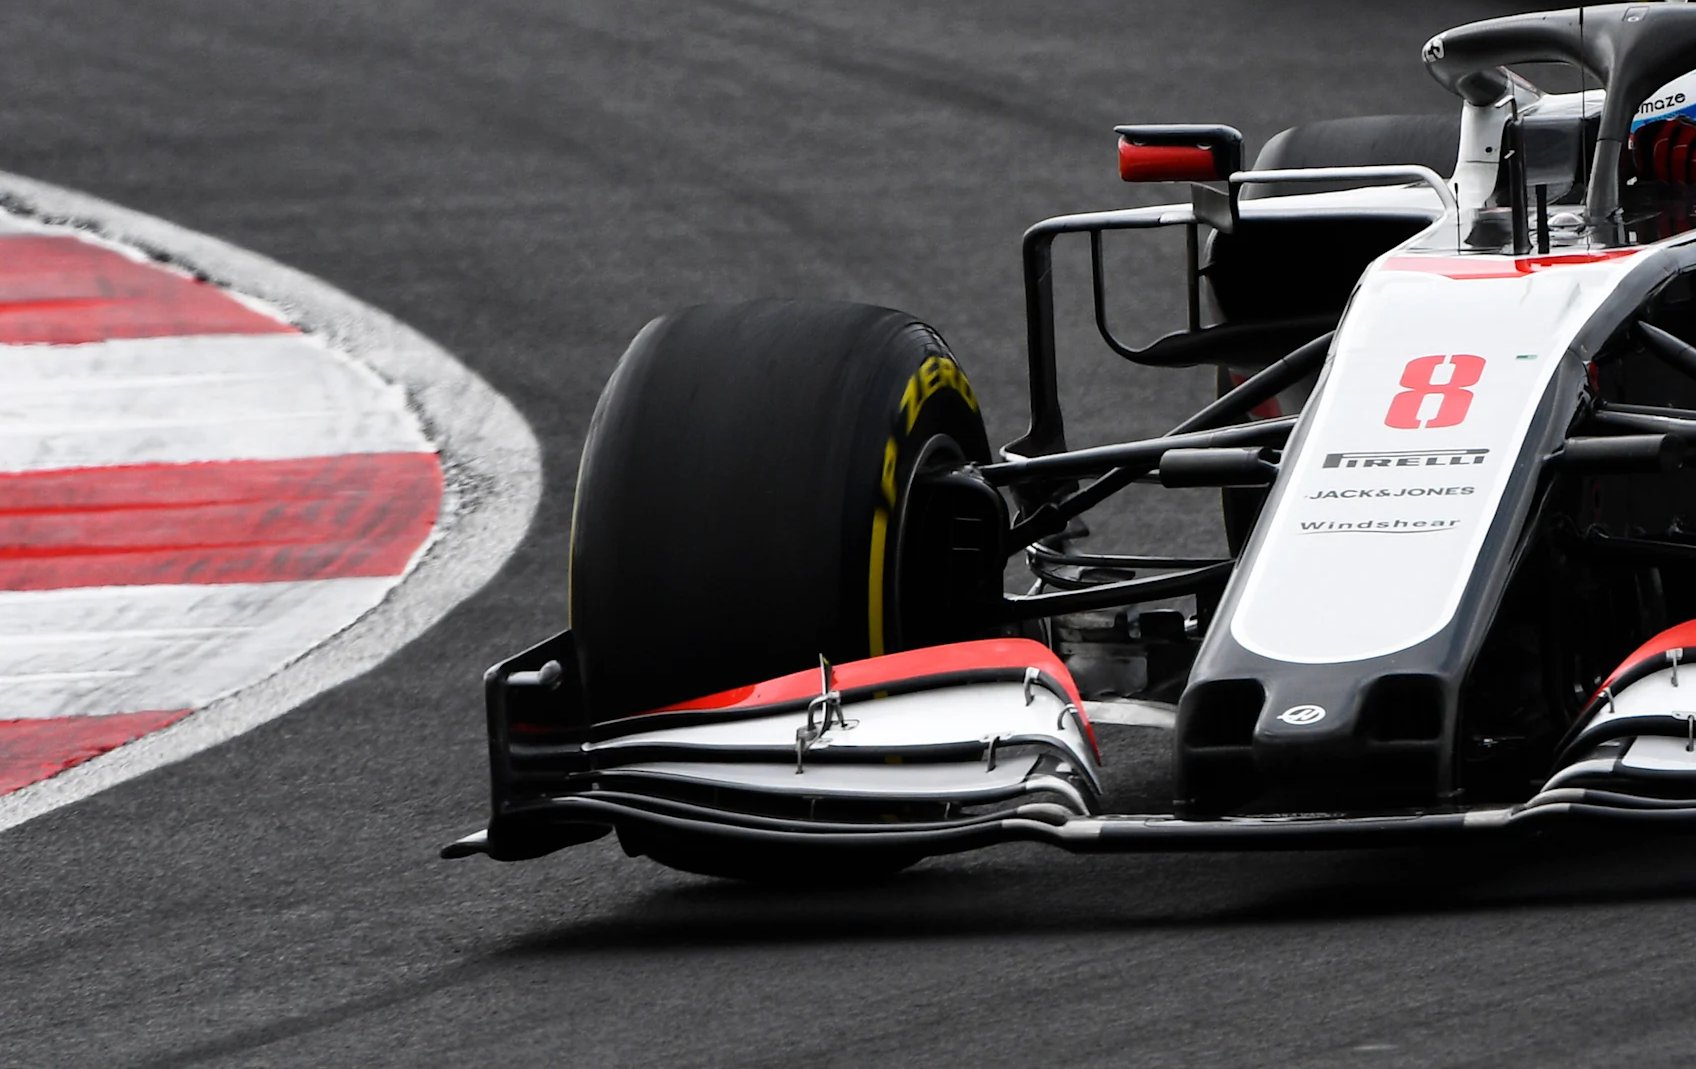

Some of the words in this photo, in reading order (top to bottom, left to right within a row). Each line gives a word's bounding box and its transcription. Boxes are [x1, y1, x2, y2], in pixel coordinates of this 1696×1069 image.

[1384, 354, 1486, 429] 8
[1322, 448, 1490, 469] PIRELLI
[1309, 486, 1475, 500] JACK&JONES
[1300, 519, 1461, 530] Windshear
